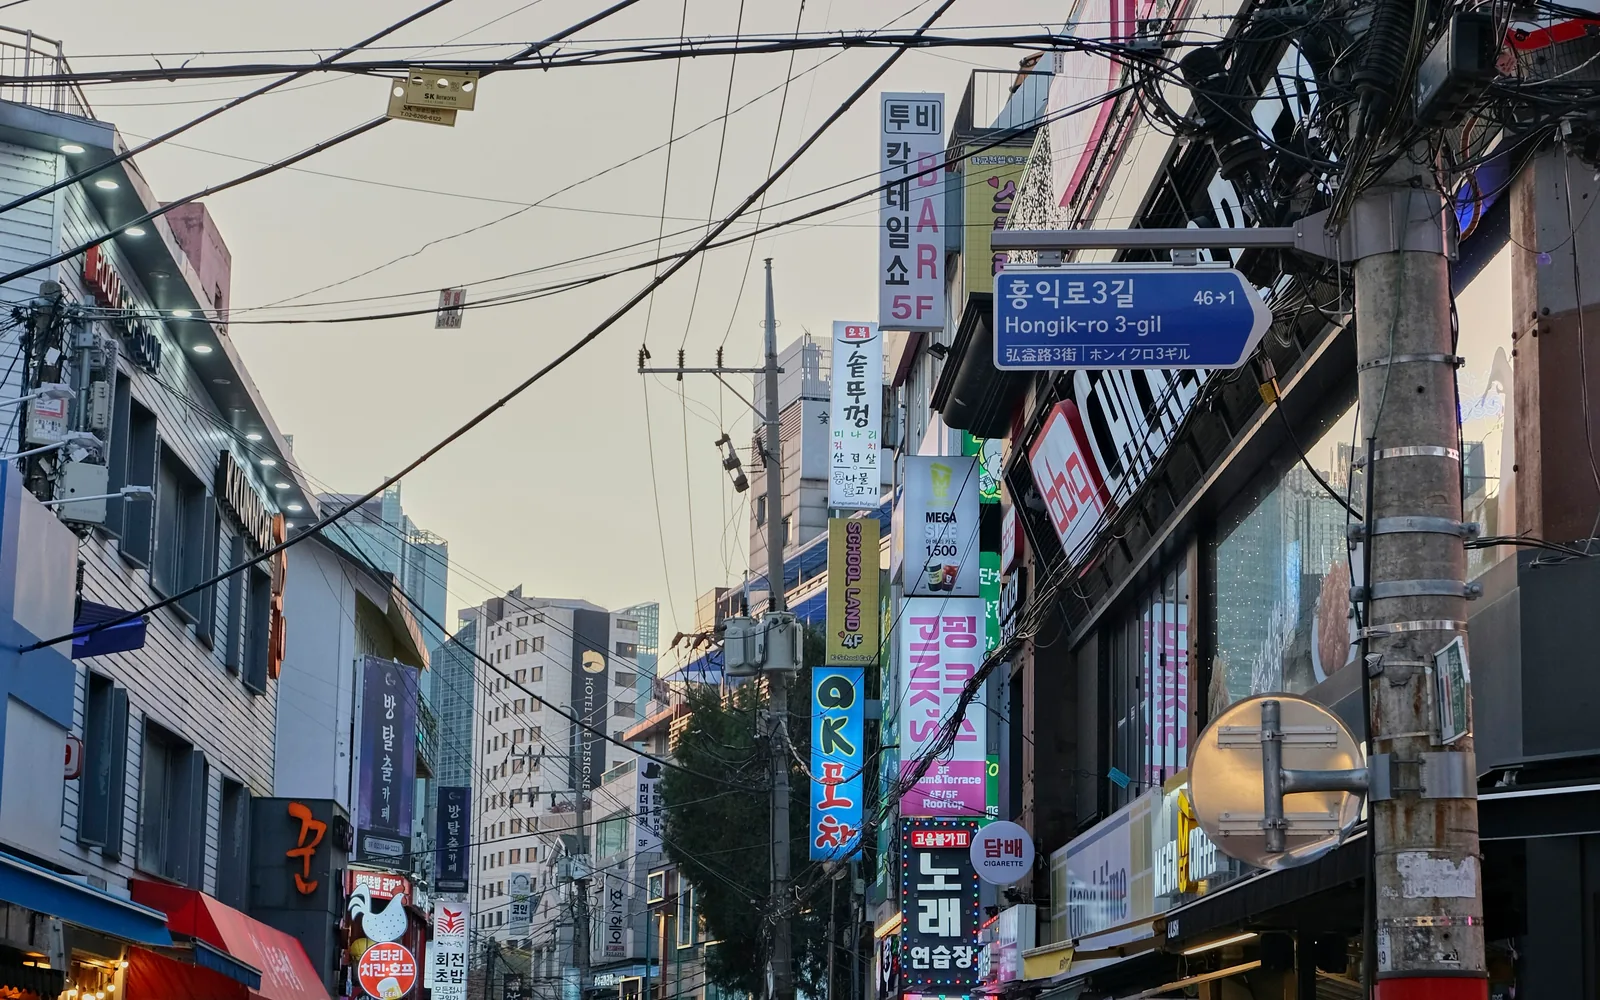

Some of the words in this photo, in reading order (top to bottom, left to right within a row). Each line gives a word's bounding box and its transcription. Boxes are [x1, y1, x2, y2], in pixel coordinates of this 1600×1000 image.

[889, 104, 936, 132] 투비
[885, 140, 912, 287] 칵테일쇼
[917, 151, 938, 280] BAR
[1006, 279, 1135, 310] 홍익로3길
[892, 295, 933, 320] 5F
[1006, 316, 1109, 339] Hongik-ro
[1115, 315, 1161, 338] 3-gil
[1006, 347, 1077, 362] 弘益路3街
[1090, 347, 1191, 362] ホンイクロ3ギル
[843, 350, 870, 429] 솥뚜껑
[834, 430, 877, 440] 미나리
[833, 452, 877, 465] 삼겹살
[833, 471, 869, 486] 콩나물
[843, 483, 878, 498] 불고기
[1045, 451, 1093, 535] bbq
[926, 511, 957, 523] MEGA
[924, 524, 957, 539] SIZE
[845, 522, 862, 587] SCHOOL
[845, 588, 861, 632] LAND
[842, 633, 863, 649] 4F
[909, 616, 940, 742] PINK'S
[585, 677, 594, 713] HOTEL
[381, 693, 397, 824] 방탈출카페
[938, 765, 950, 775] 3F
[917, 774, 982, 786] oom&Terrace
[929, 790, 958, 799] 4F/5F
[923, 799, 965, 811] Rooftop
[447, 804, 461, 873] 방탈출카페
[638, 839, 648, 847] 3F
[984, 838, 1023, 859] 담배
[983, 860, 1024, 868] CIGARETTE
[1154, 839, 1178, 899] MEGA
[917, 852, 962, 937] 노래
[512, 904, 528, 915] 코인
[370, 948, 404, 962] 로타리
[435, 952, 464, 968] 회전
[911, 945, 974, 970] 연습장
[434, 968, 465, 984] 초밥
